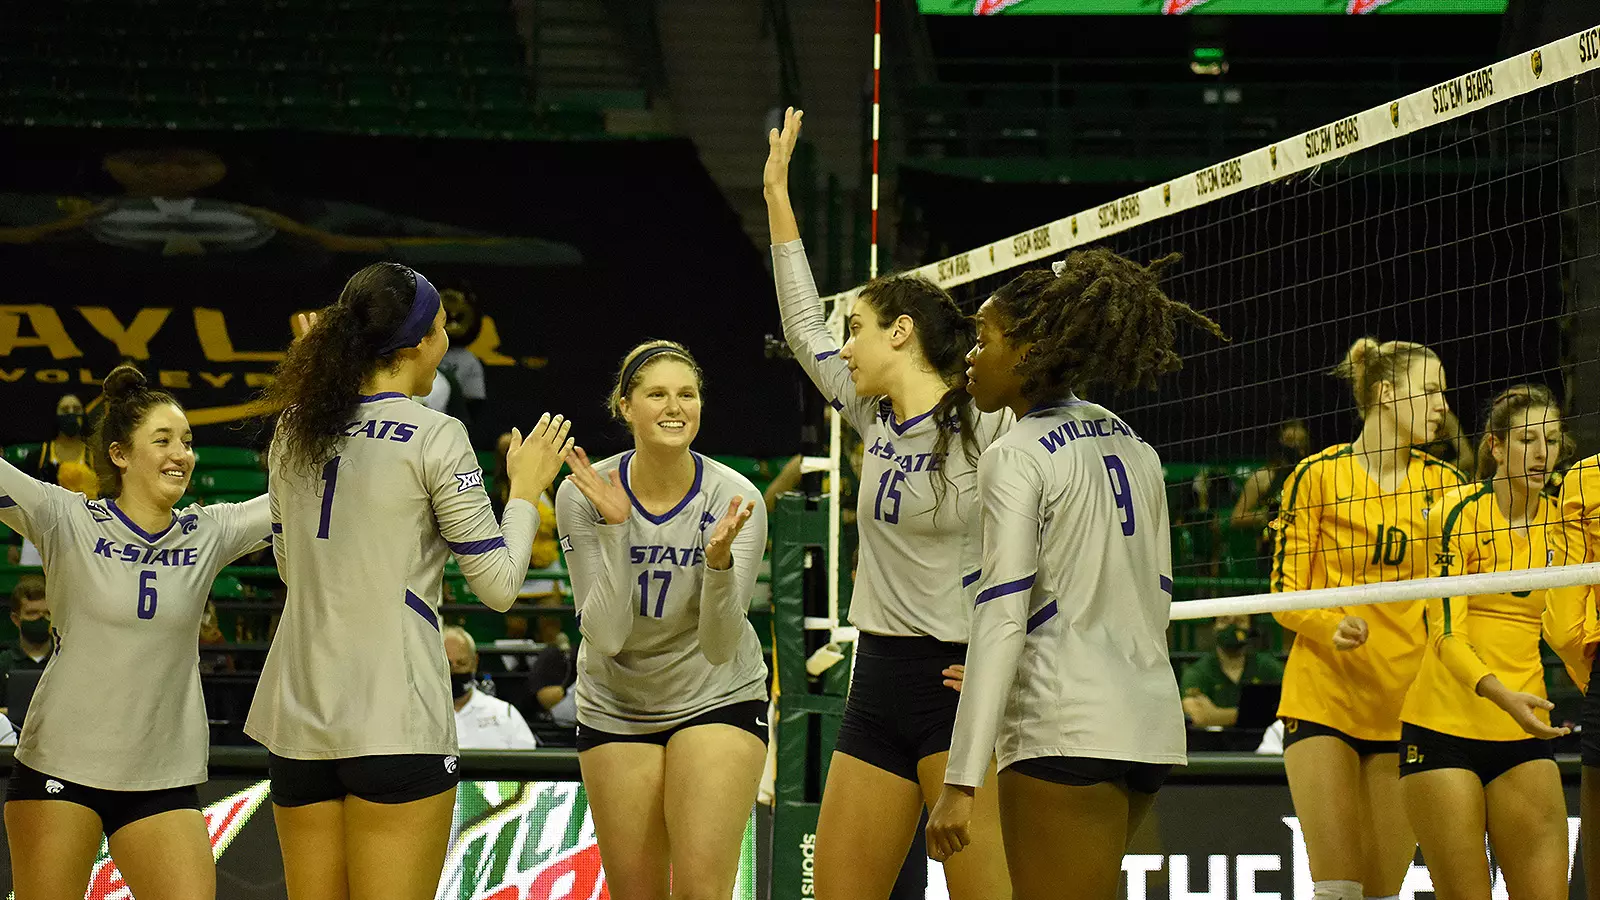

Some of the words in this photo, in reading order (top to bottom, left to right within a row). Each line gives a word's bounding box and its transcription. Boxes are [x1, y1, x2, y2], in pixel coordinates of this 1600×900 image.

[1465, 67, 1493, 103] BEARS
[1335, 116, 1359, 149] BEARS
[1220, 158, 1242, 188] BEARS
[327, 419, 419, 443] CATS
[316, 455, 341, 540] 1
[873, 467, 906, 525] 15
[1103, 454, 1135, 537] 9
[93, 537, 198, 566] K-STATE
[1371, 523, 1407, 566] 10
[137, 570, 158, 620] 6
[637, 570, 672, 618] 17
